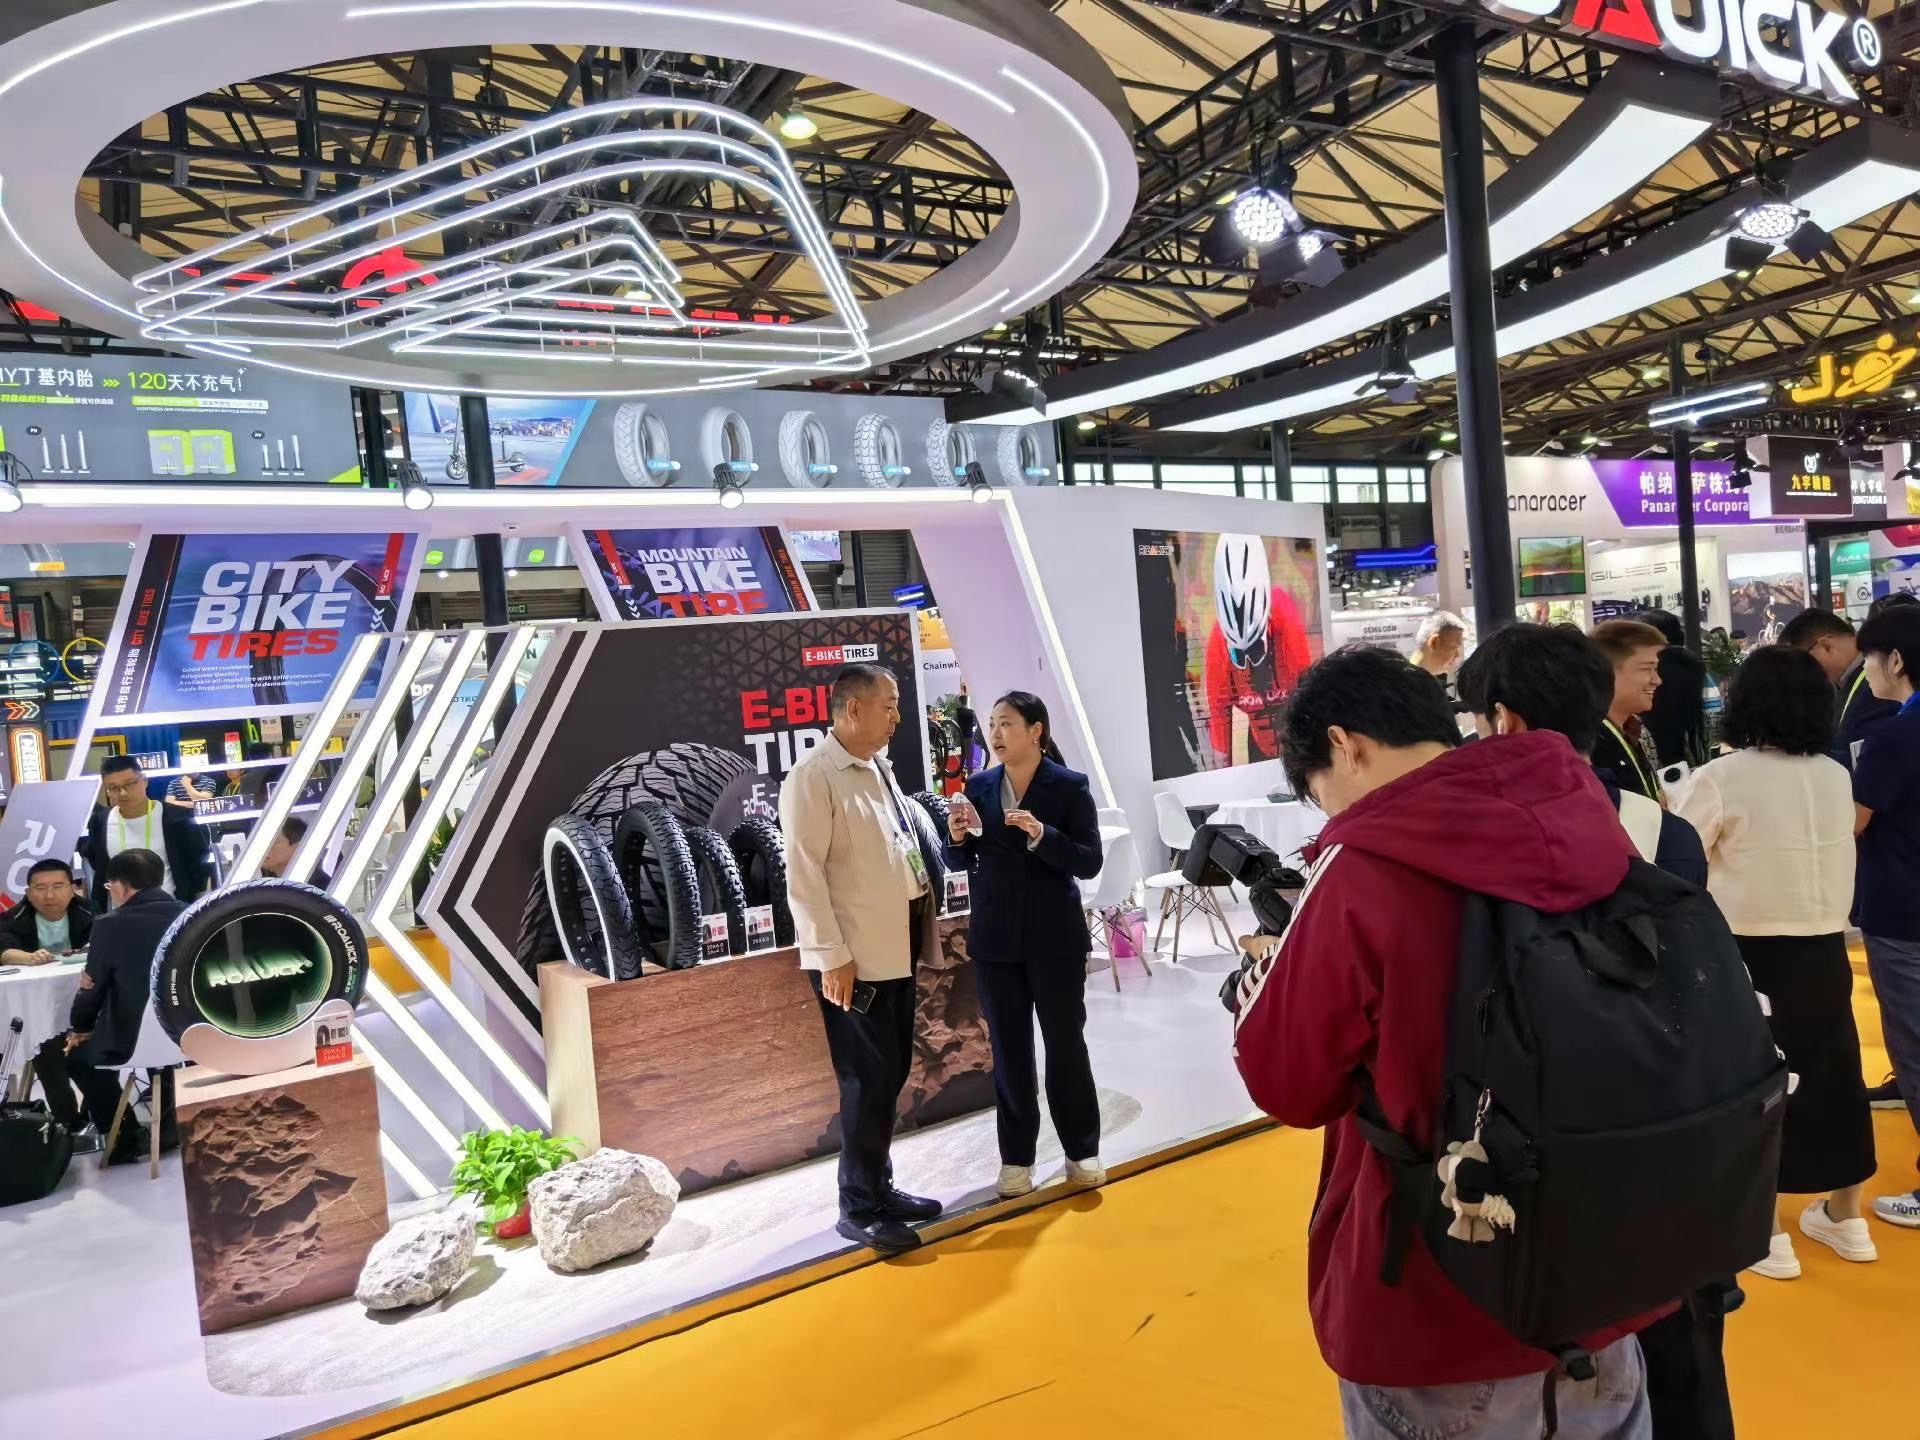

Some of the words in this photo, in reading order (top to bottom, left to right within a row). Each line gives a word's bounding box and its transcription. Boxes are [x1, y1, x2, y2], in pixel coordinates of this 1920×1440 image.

[0, 367, 94, 388] Y丁基内胎
[637, 546, 748, 564] MOUNTAIN
[202, 559, 357, 596] CITY
[644, 560, 762, 594] BIKE
[190, 591, 352, 634] BIKE
[187, 629, 340, 661] TIRES
[806, 650, 841, 662] E-BIKE
[844, 648, 875, 659] TIRES
[741, 685, 834, 729] E-BI
